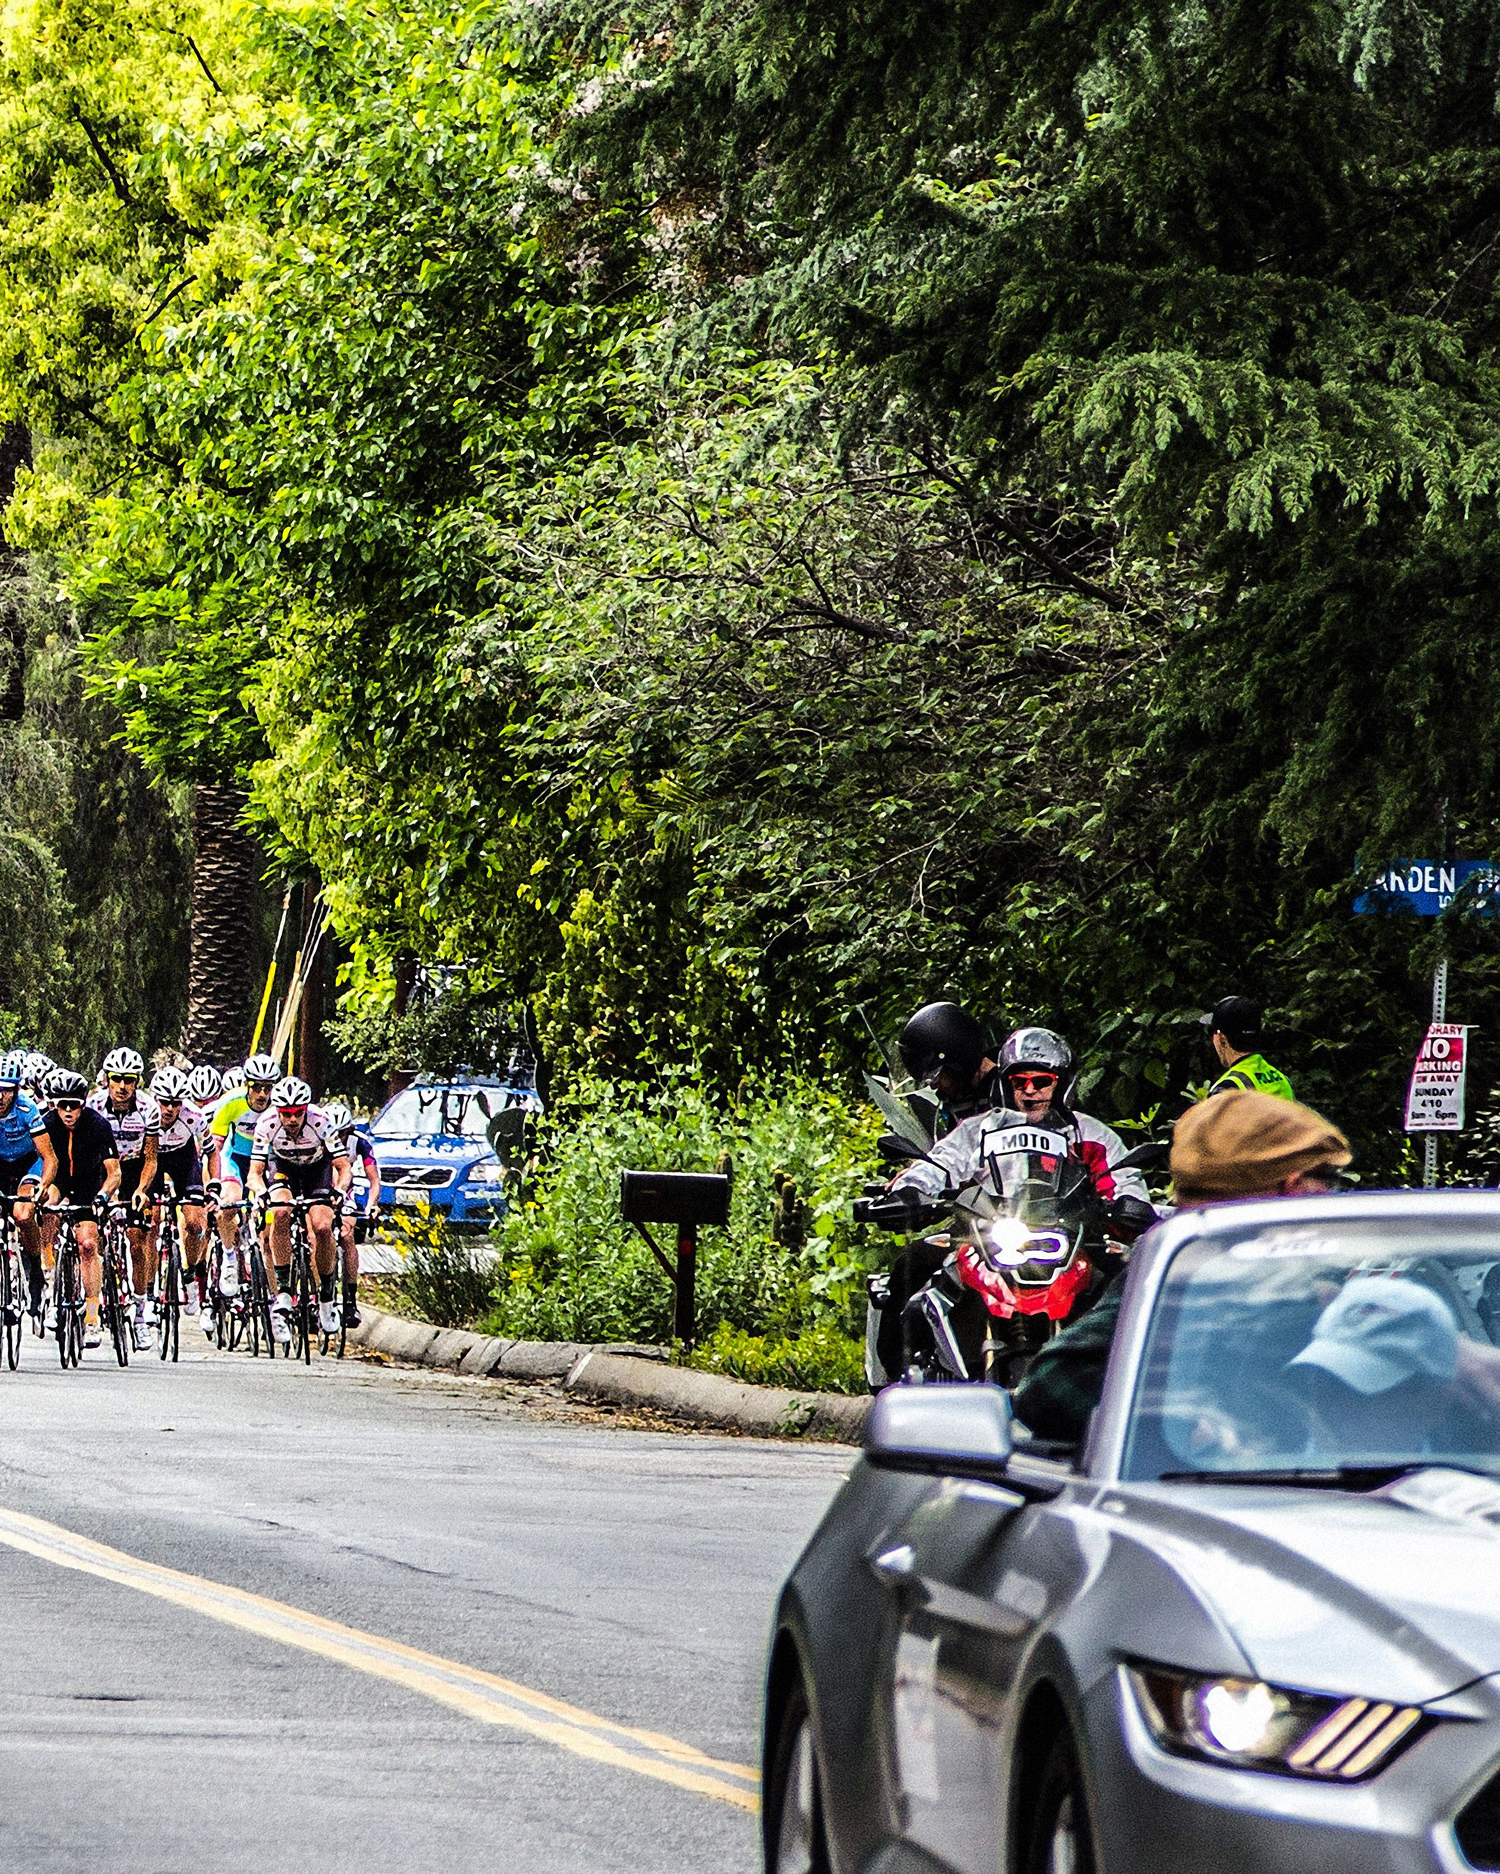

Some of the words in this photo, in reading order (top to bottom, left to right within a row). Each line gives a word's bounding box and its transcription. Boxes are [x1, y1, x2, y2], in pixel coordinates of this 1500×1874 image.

[1364, 866, 1456, 892] ARDEN
[1421, 1038, 1451, 1059] NO
[1430, 1075, 1459, 1083] AWAY
[1414, 1087, 1455, 1097] SUNDAY
[1002, 1133, 1050, 1150] MOTO
